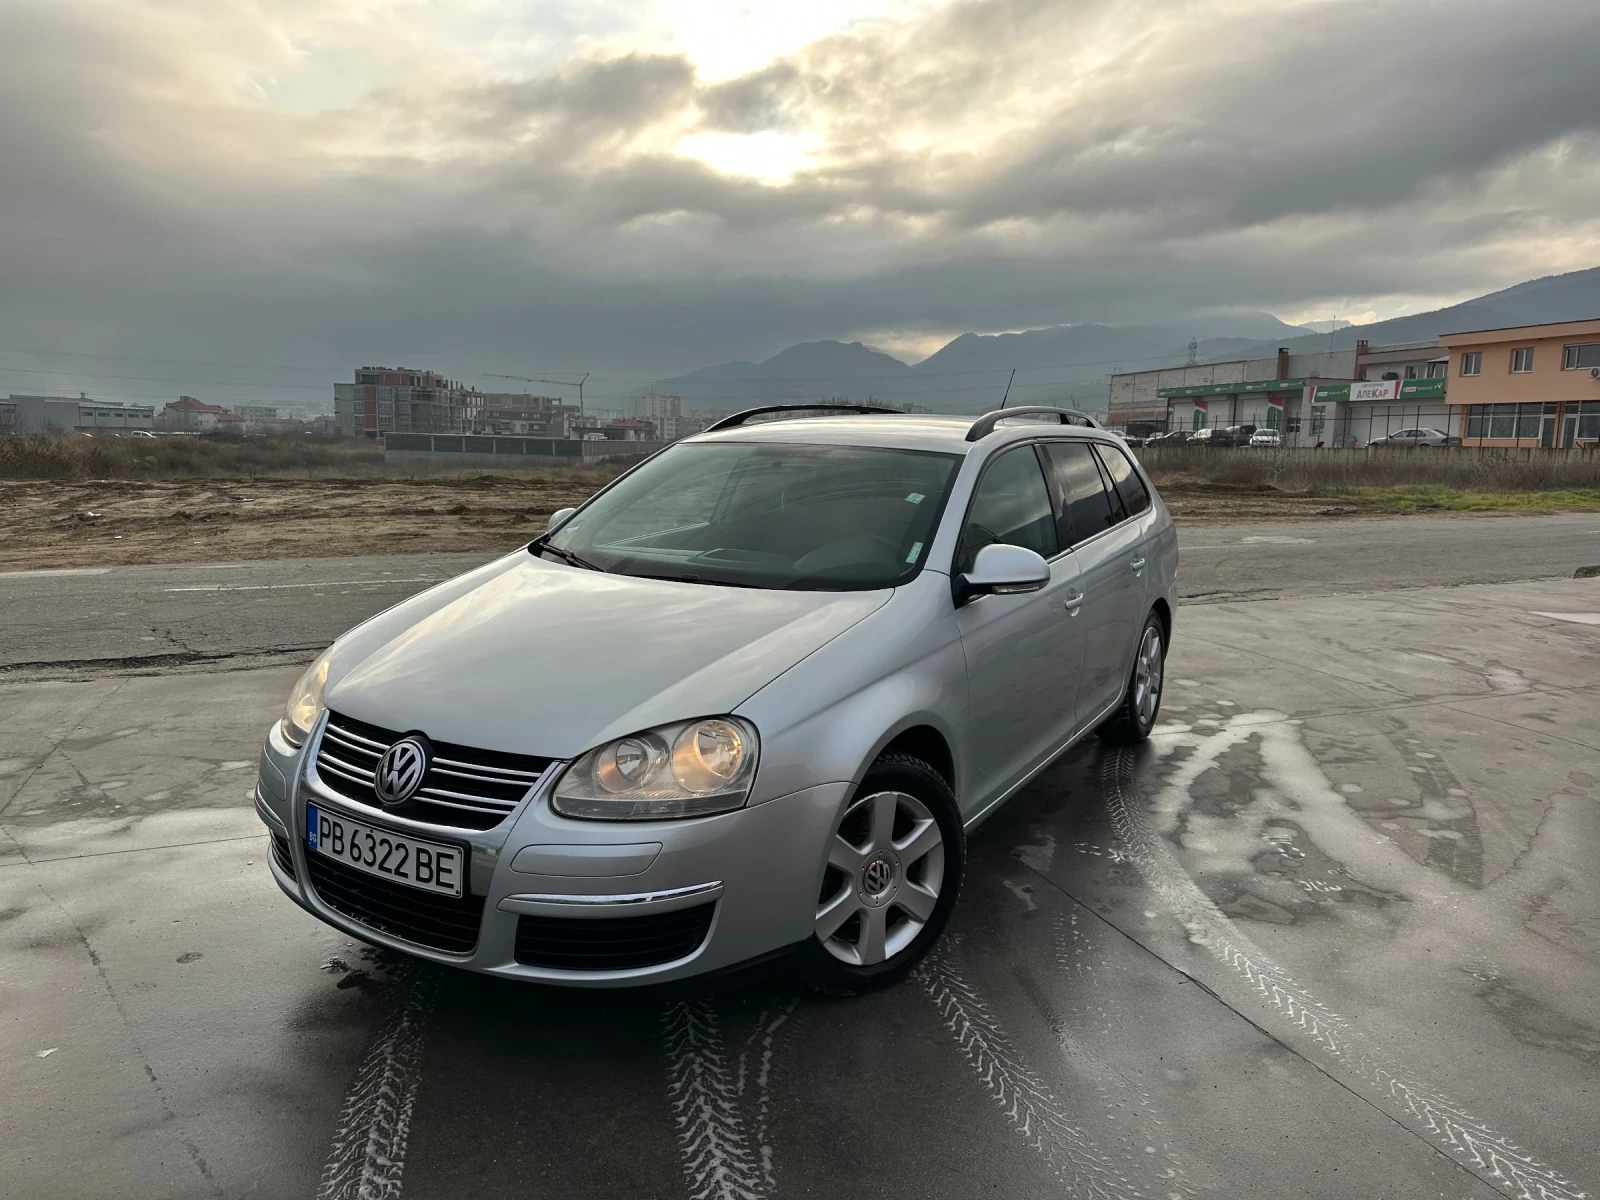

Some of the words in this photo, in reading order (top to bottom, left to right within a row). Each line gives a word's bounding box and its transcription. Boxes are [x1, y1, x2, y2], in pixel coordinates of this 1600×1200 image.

[309, 831, 317, 843] BG
[319, 815, 344, 855] PB
[350, 829, 409, 879] 6322
[416, 847, 455, 889] BE
